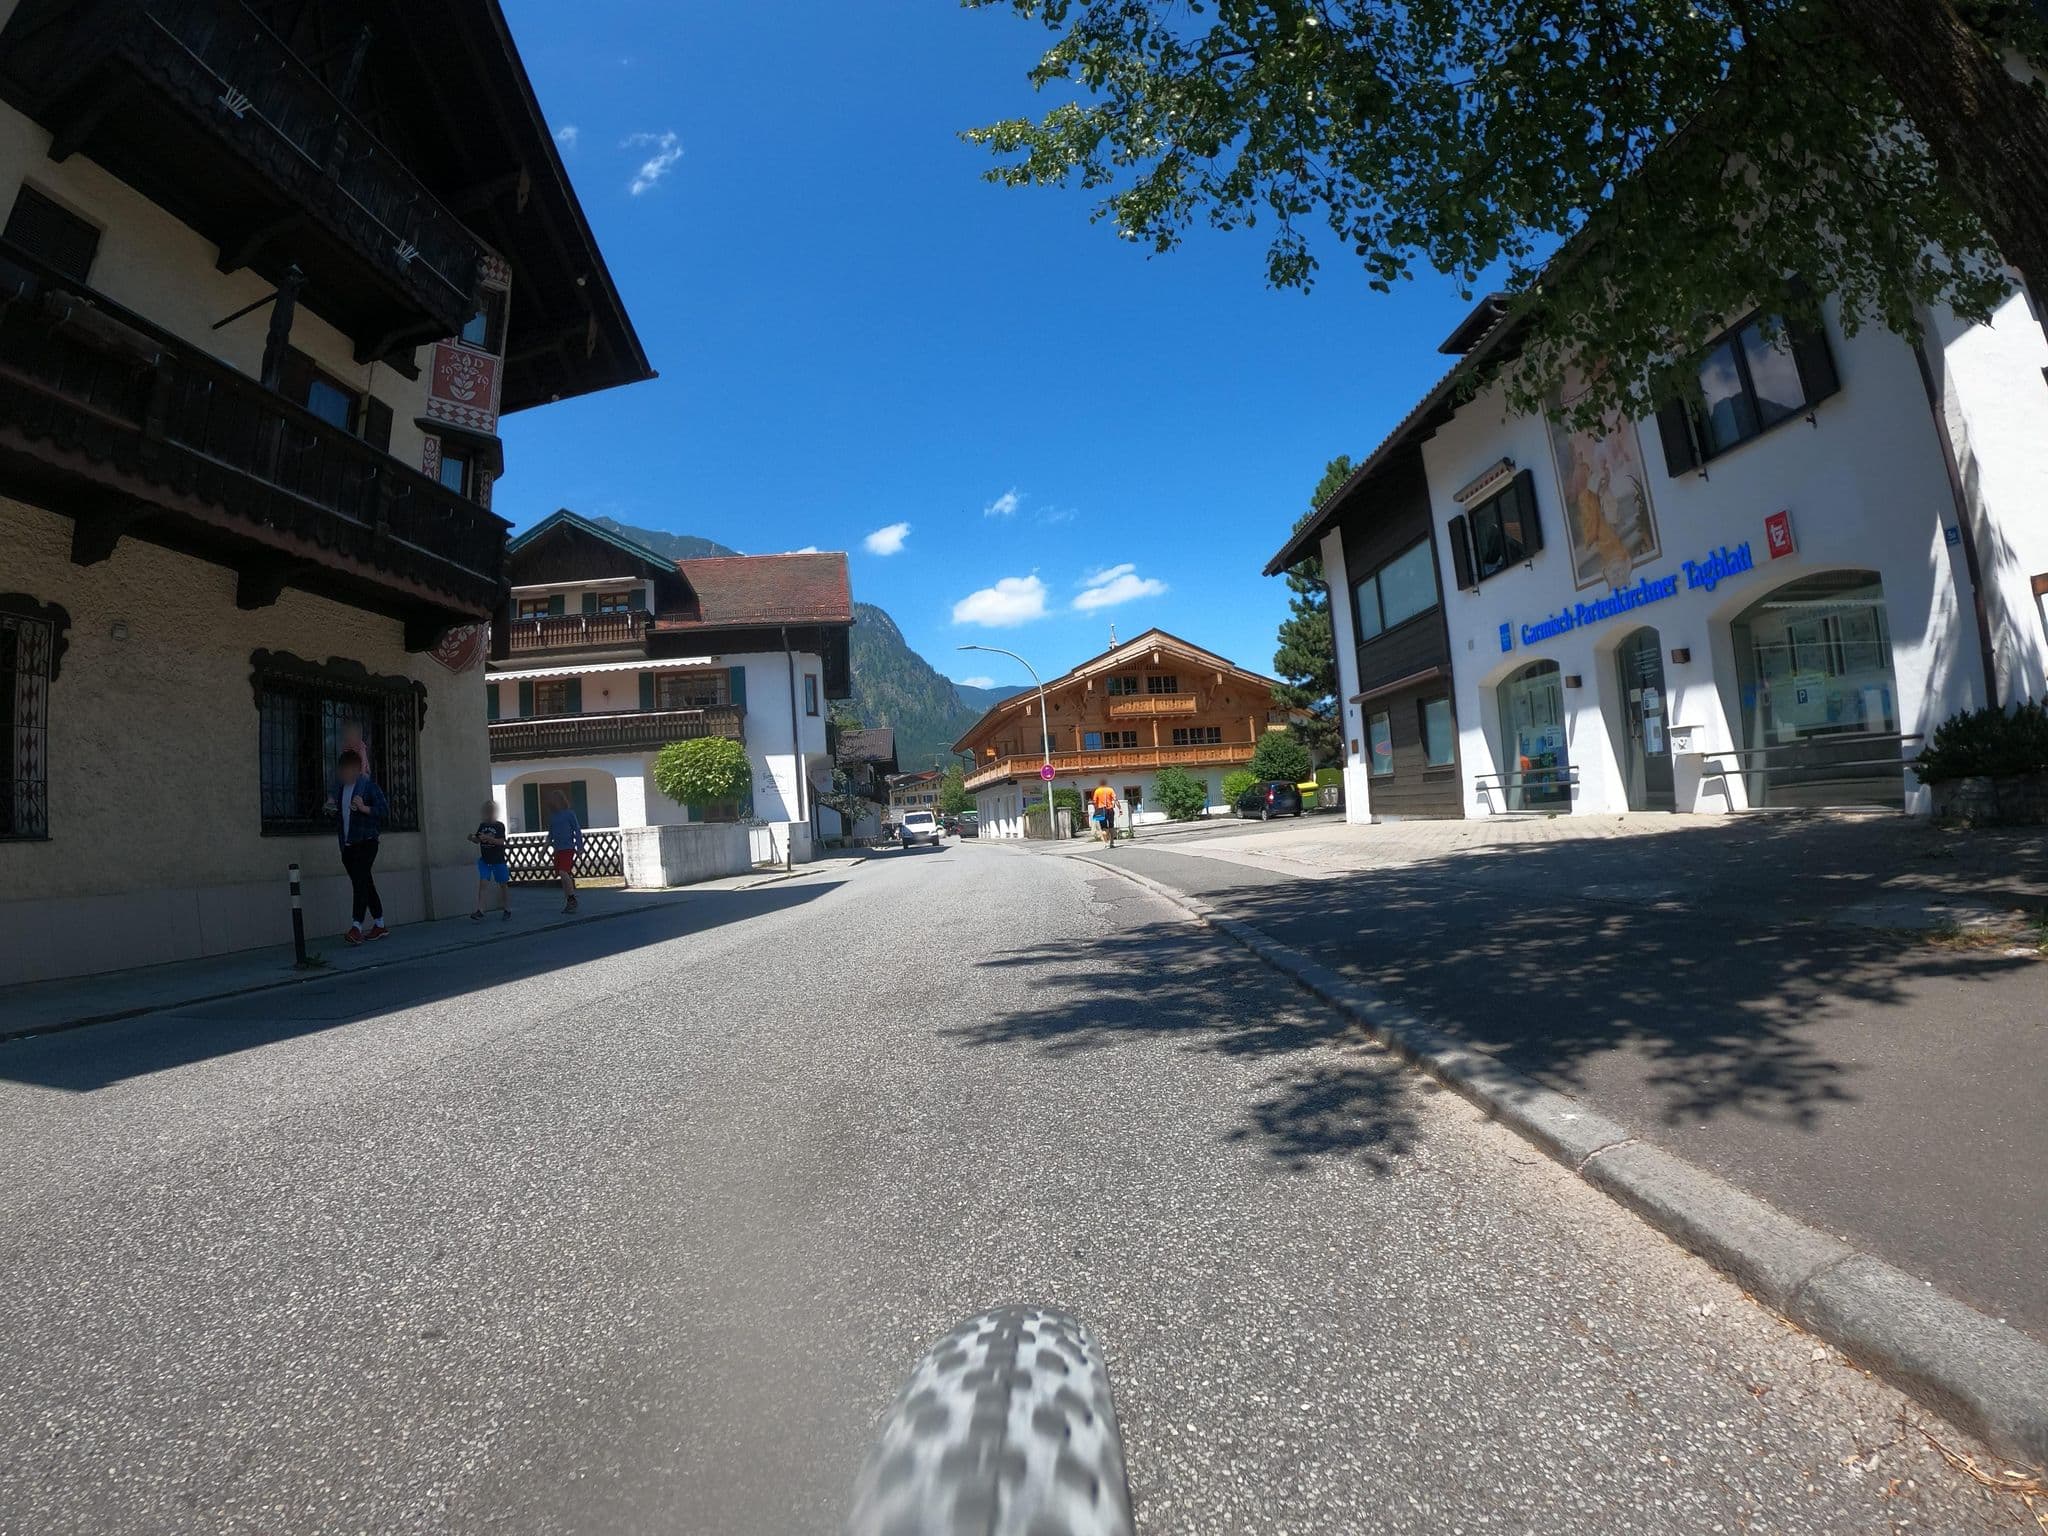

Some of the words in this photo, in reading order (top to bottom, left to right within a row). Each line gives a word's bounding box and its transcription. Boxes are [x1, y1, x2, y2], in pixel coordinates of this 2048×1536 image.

[1770, 524, 1786, 548] tz
[1521, 574, 1678, 646] Garmisch-Partenkirchner
[1682, 541, 1753, 592] Tagblatt
